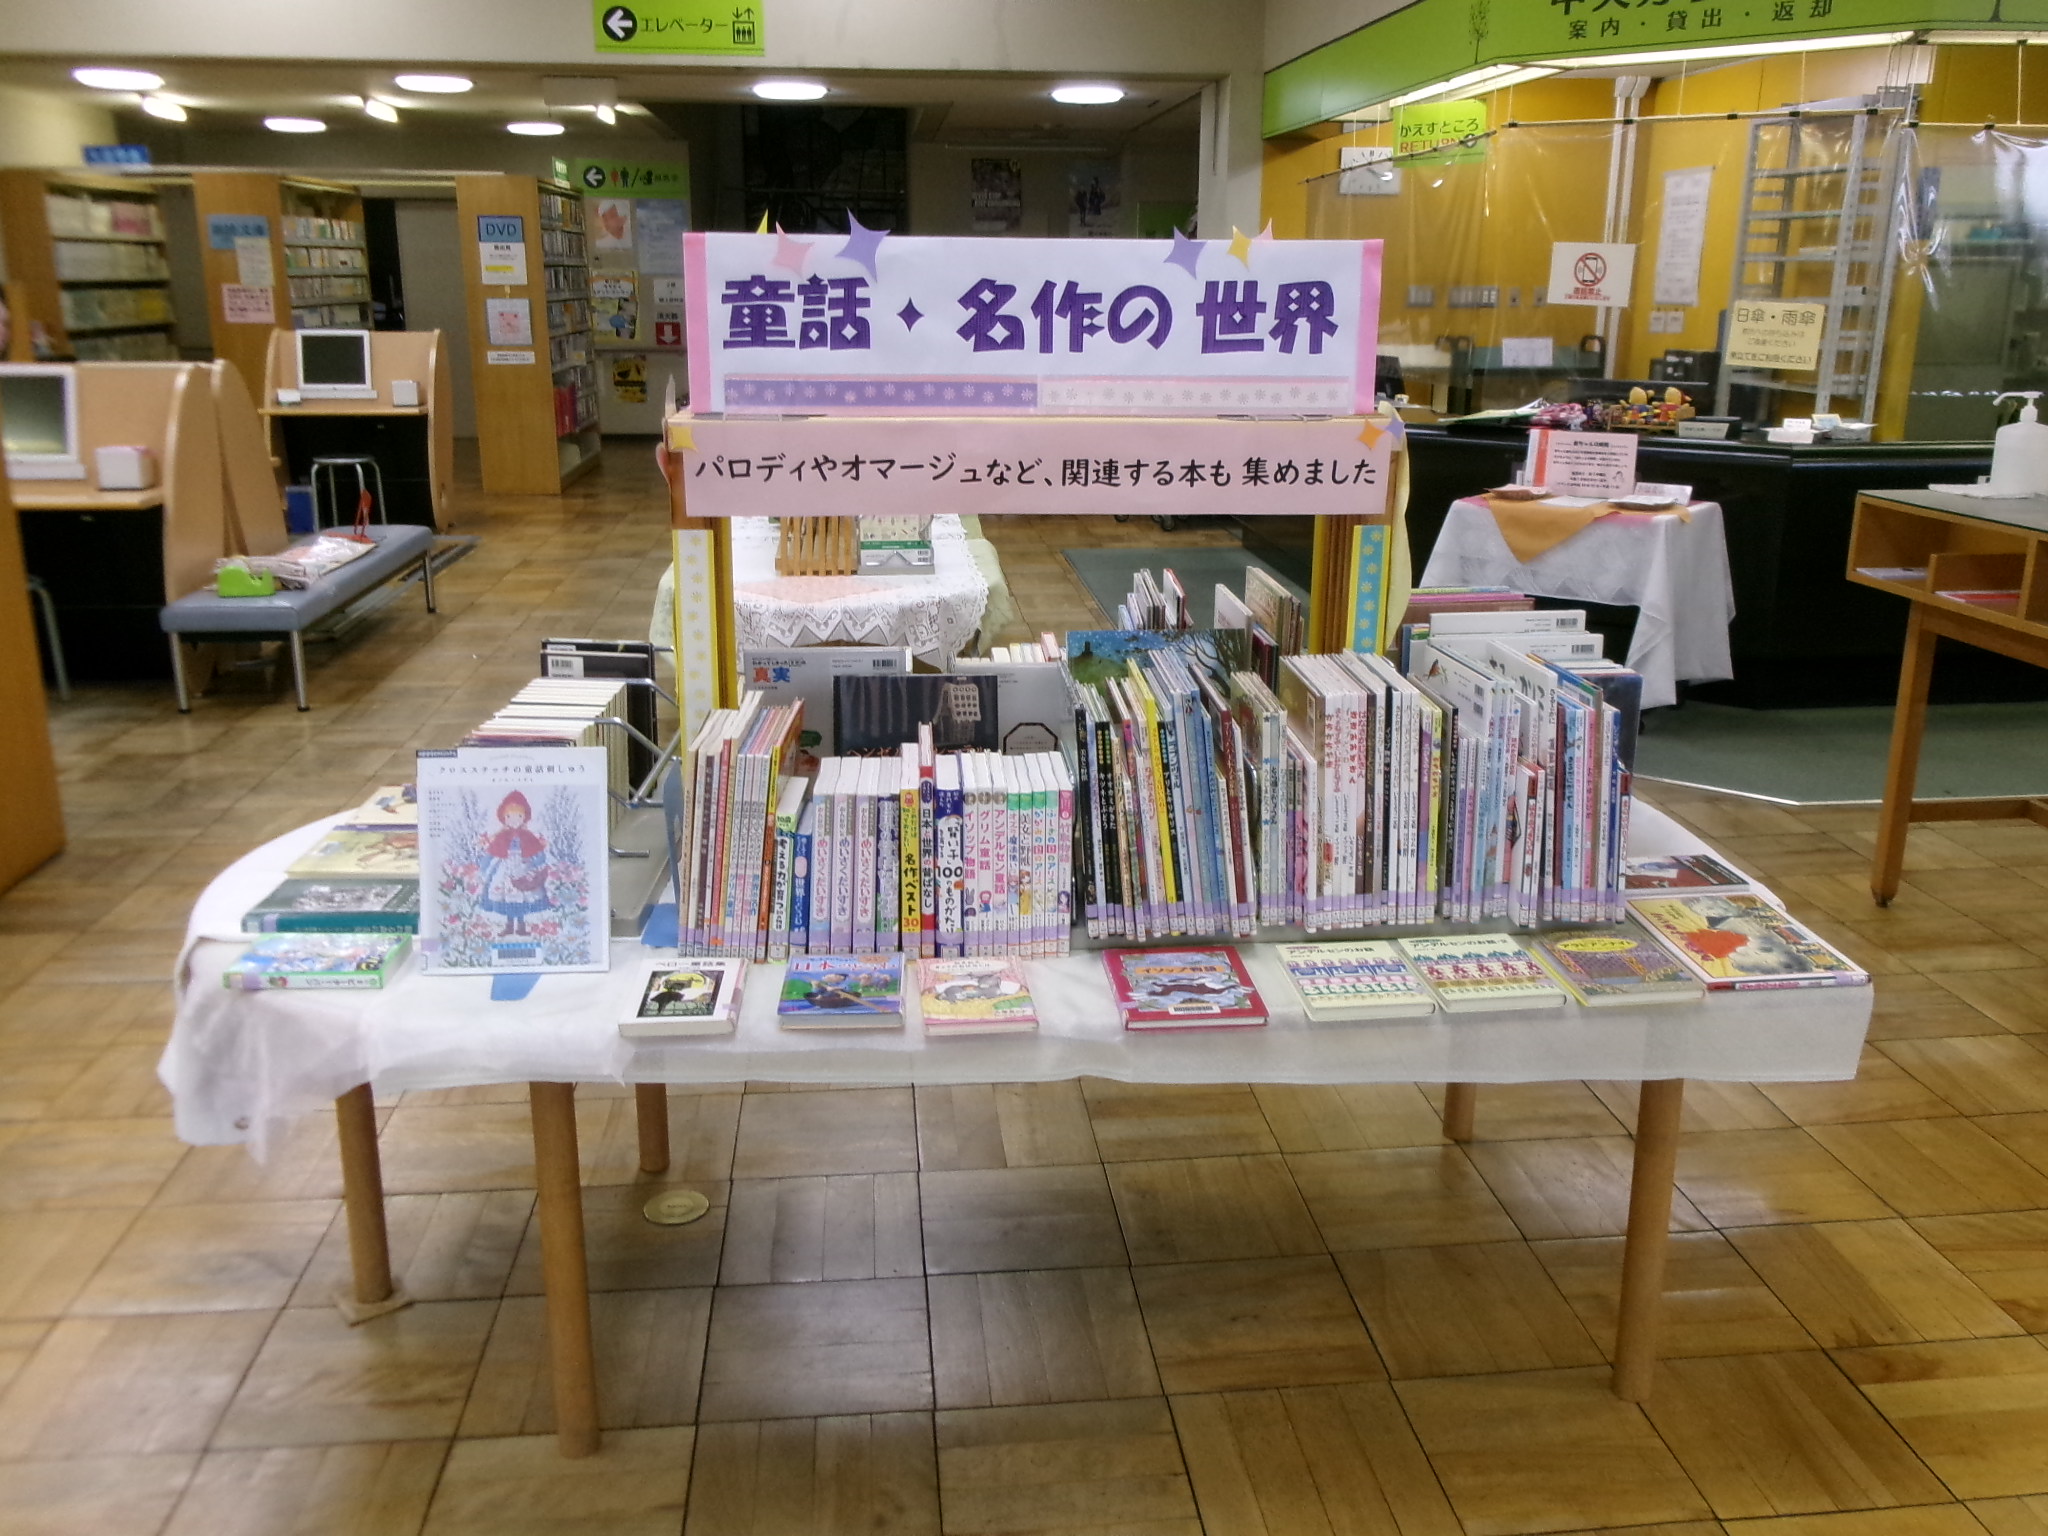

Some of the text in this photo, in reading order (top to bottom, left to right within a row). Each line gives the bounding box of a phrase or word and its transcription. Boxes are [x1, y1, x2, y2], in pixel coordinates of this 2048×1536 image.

[640, 18, 728, 33] エレベーター
[1568, 1, 1832, 40] 案内・貸出・返却
[1400, 118, 1479, 138] かえすところ
[485, 223, 517, 237] DVD
[1737, 308, 1817, 326] 日傘・雨傘
[1325, 713, 1335, 769] かちかちやま
[1098, 772, 1109, 830] キツネとぶどう
[921, 808, 933, 909] 日本と世界の昔ばなし
[964, 811, 976, 880] イソップ物語
[979, 811, 991, 871] グリム童話
[994, 809, 1005, 894] アンデルセン童話
[1034, 810, 1044, 886] かがみの国のアリス
